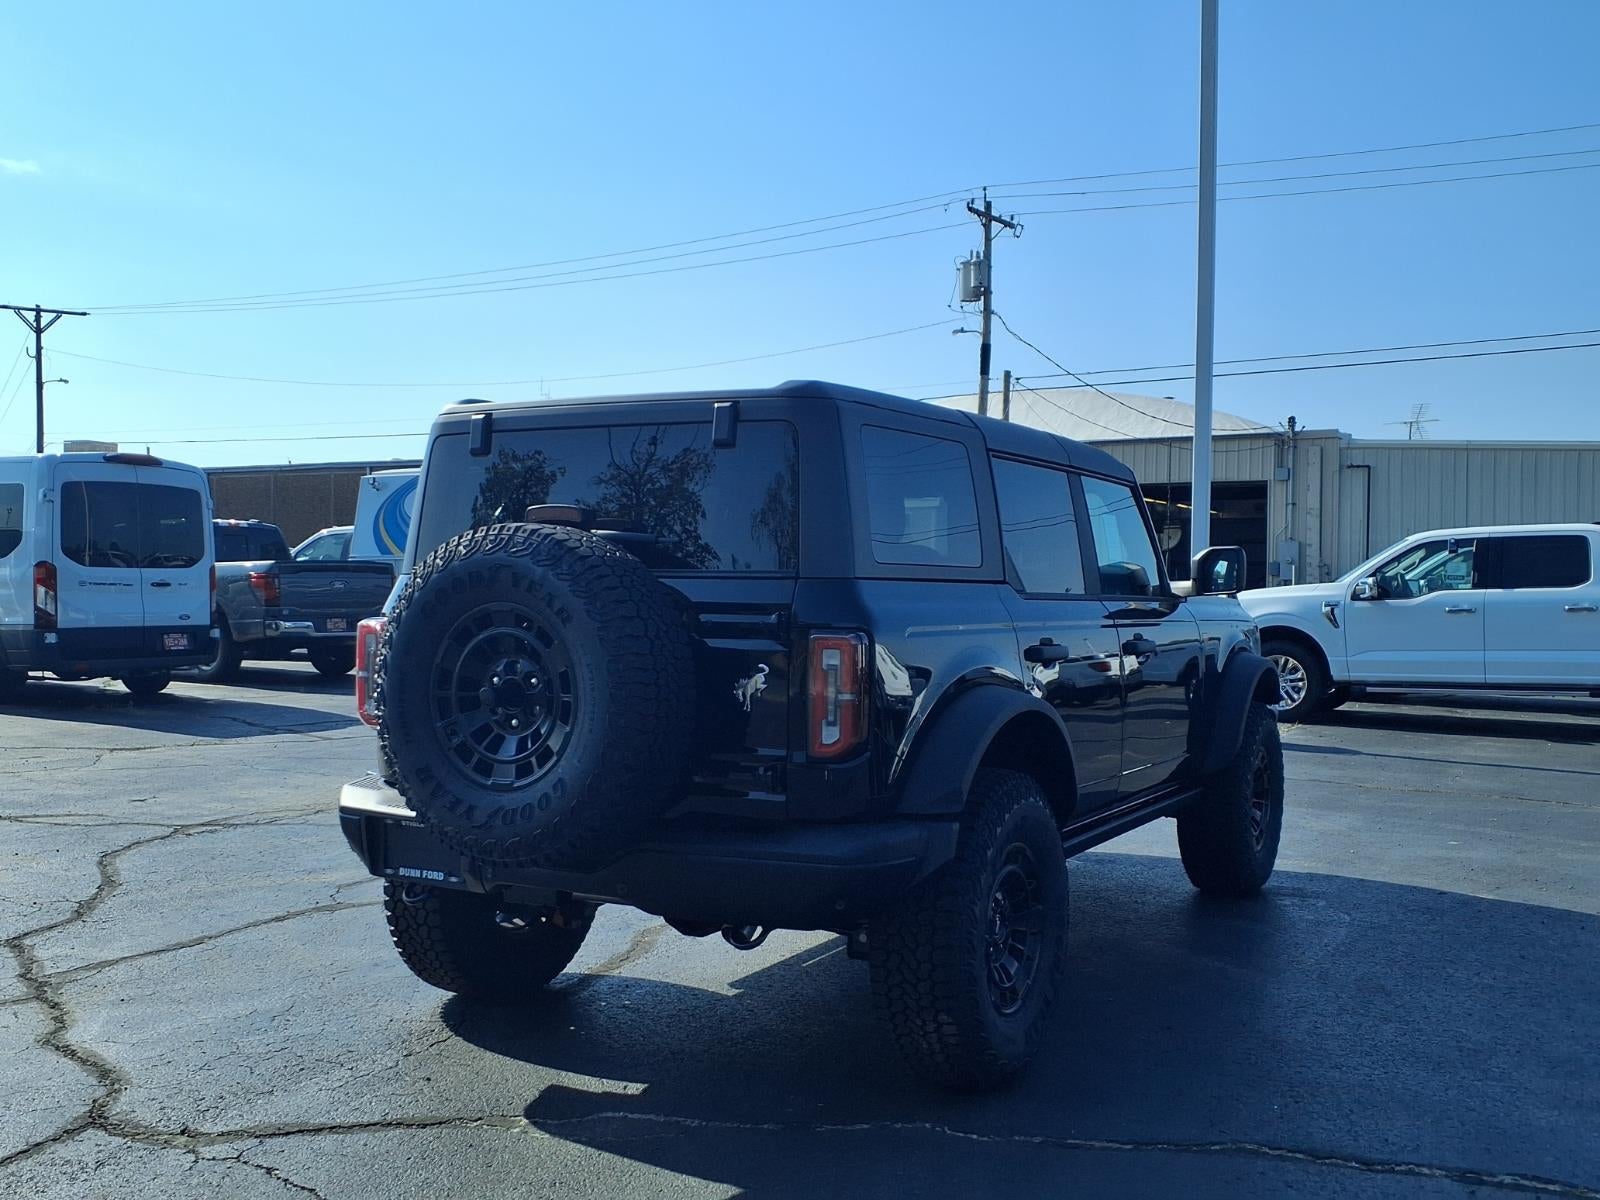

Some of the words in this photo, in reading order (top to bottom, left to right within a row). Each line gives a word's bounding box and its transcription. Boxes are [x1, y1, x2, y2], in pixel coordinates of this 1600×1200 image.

[415, 767, 567, 832] GOODYEAR
[399, 867, 421, 878] DUNN
[422, 870, 445, 881] FORD
